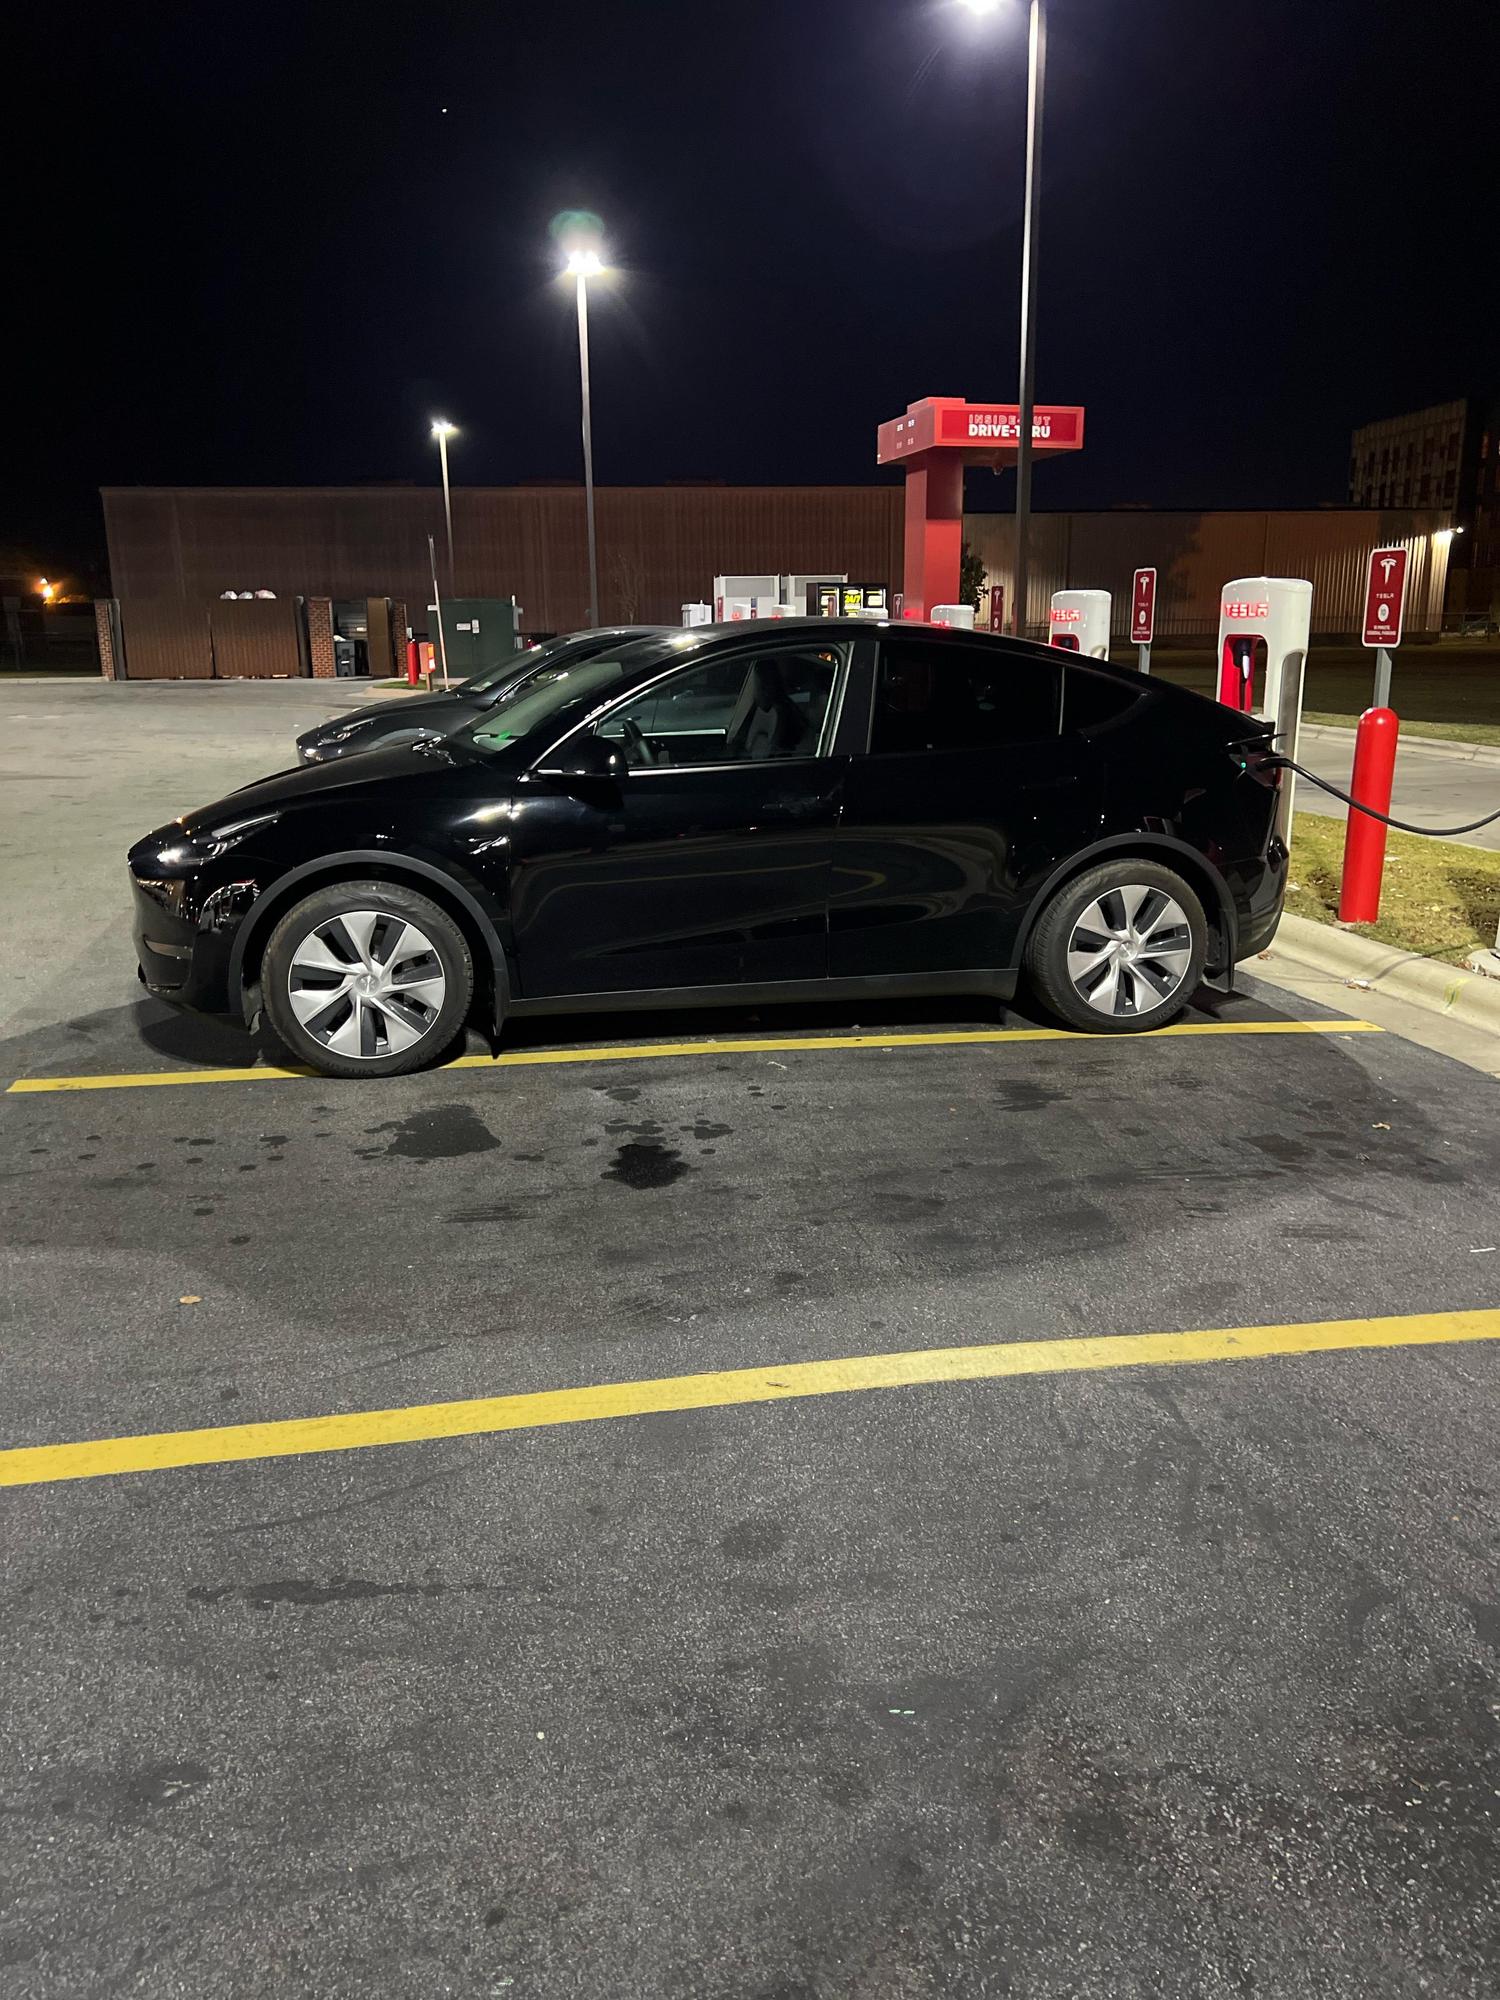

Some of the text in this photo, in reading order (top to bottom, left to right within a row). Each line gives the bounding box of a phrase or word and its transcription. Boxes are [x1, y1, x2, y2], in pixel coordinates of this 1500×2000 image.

[968, 414, 1051, 425] INSIDE-UT
[968, 424, 1051, 438] DRIVE-TRU
[844, 594, 861, 603] 24/7
[1226, 603, 1268, 617] TESLA
